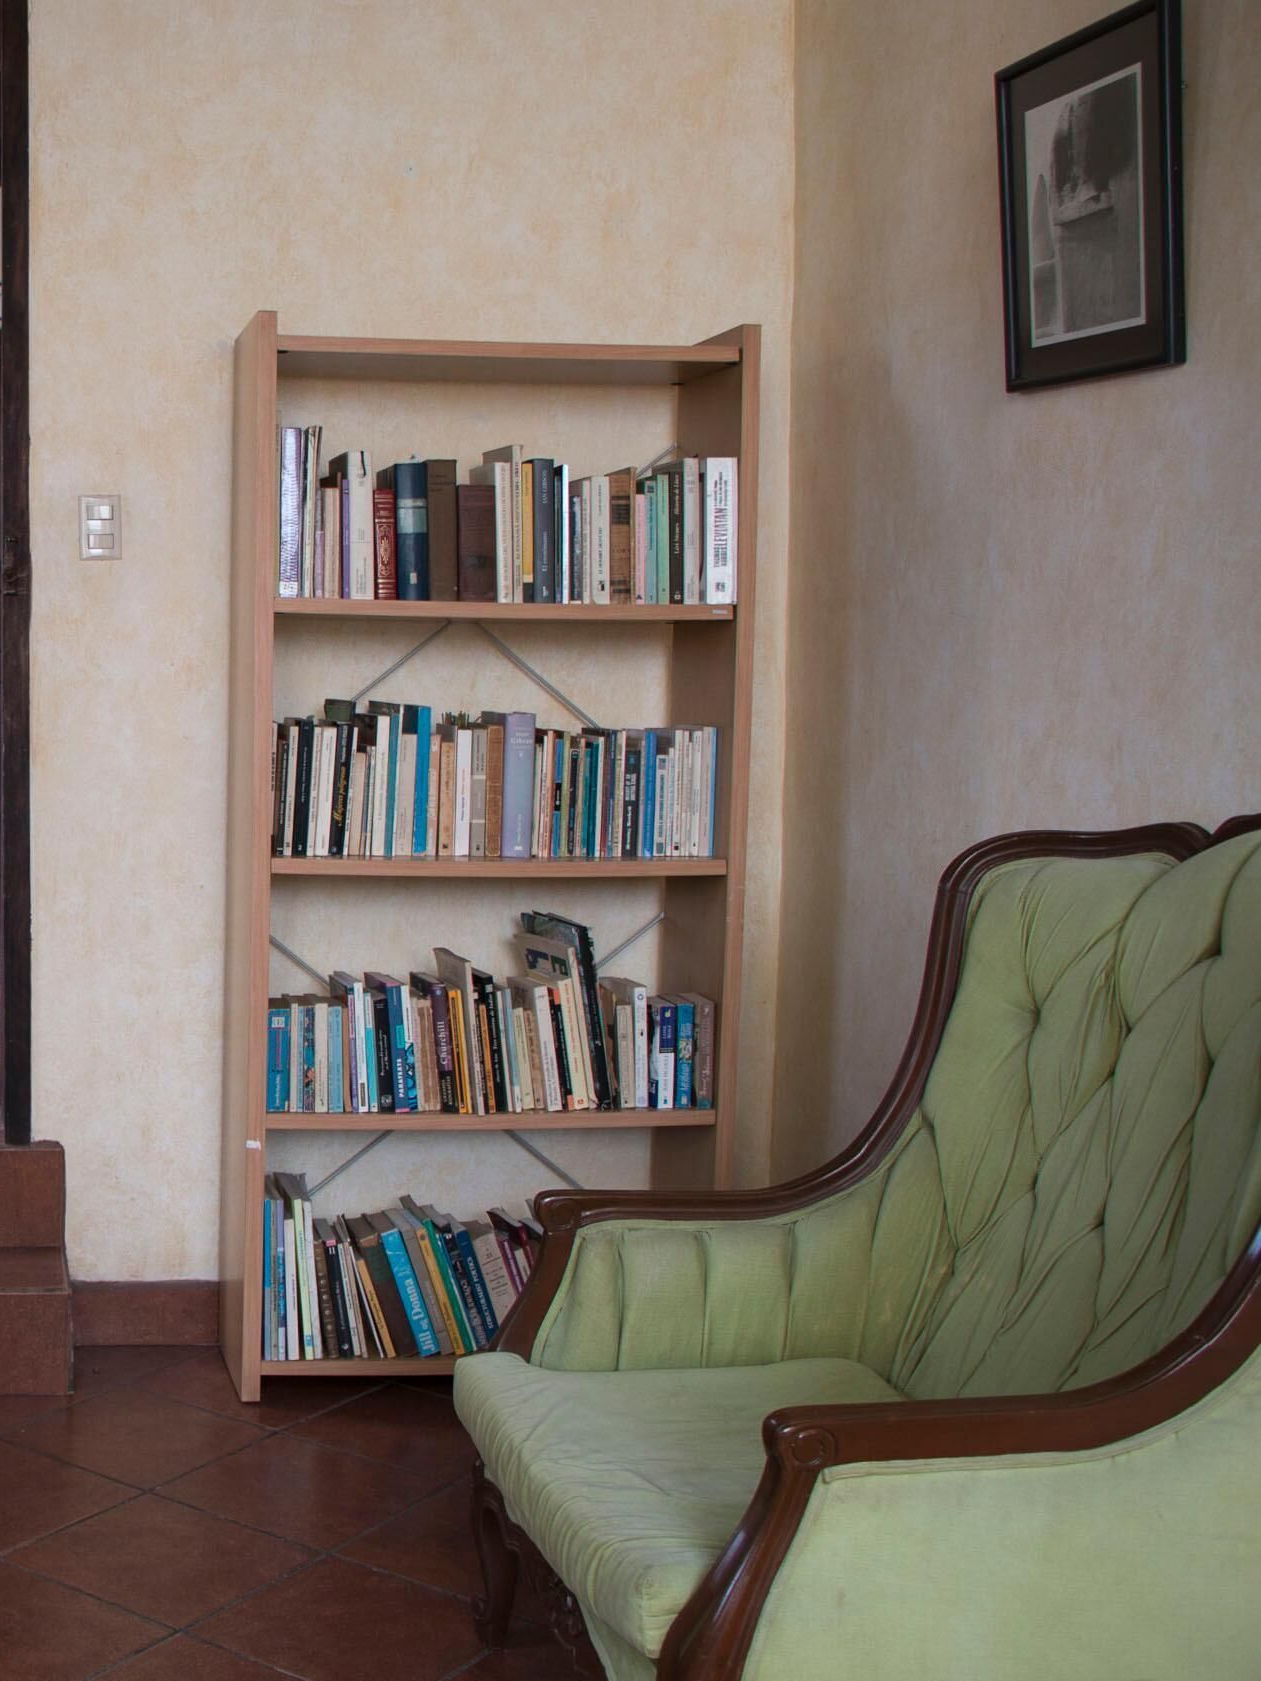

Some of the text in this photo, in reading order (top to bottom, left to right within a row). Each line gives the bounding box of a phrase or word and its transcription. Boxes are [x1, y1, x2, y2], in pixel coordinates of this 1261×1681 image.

[714, 508, 728, 547] LEVIATAN
[438, 1021, 447, 1064] Churchill
[404, 1279, 423, 1320] Donna
[418, 1331, 435, 1353] Jill
